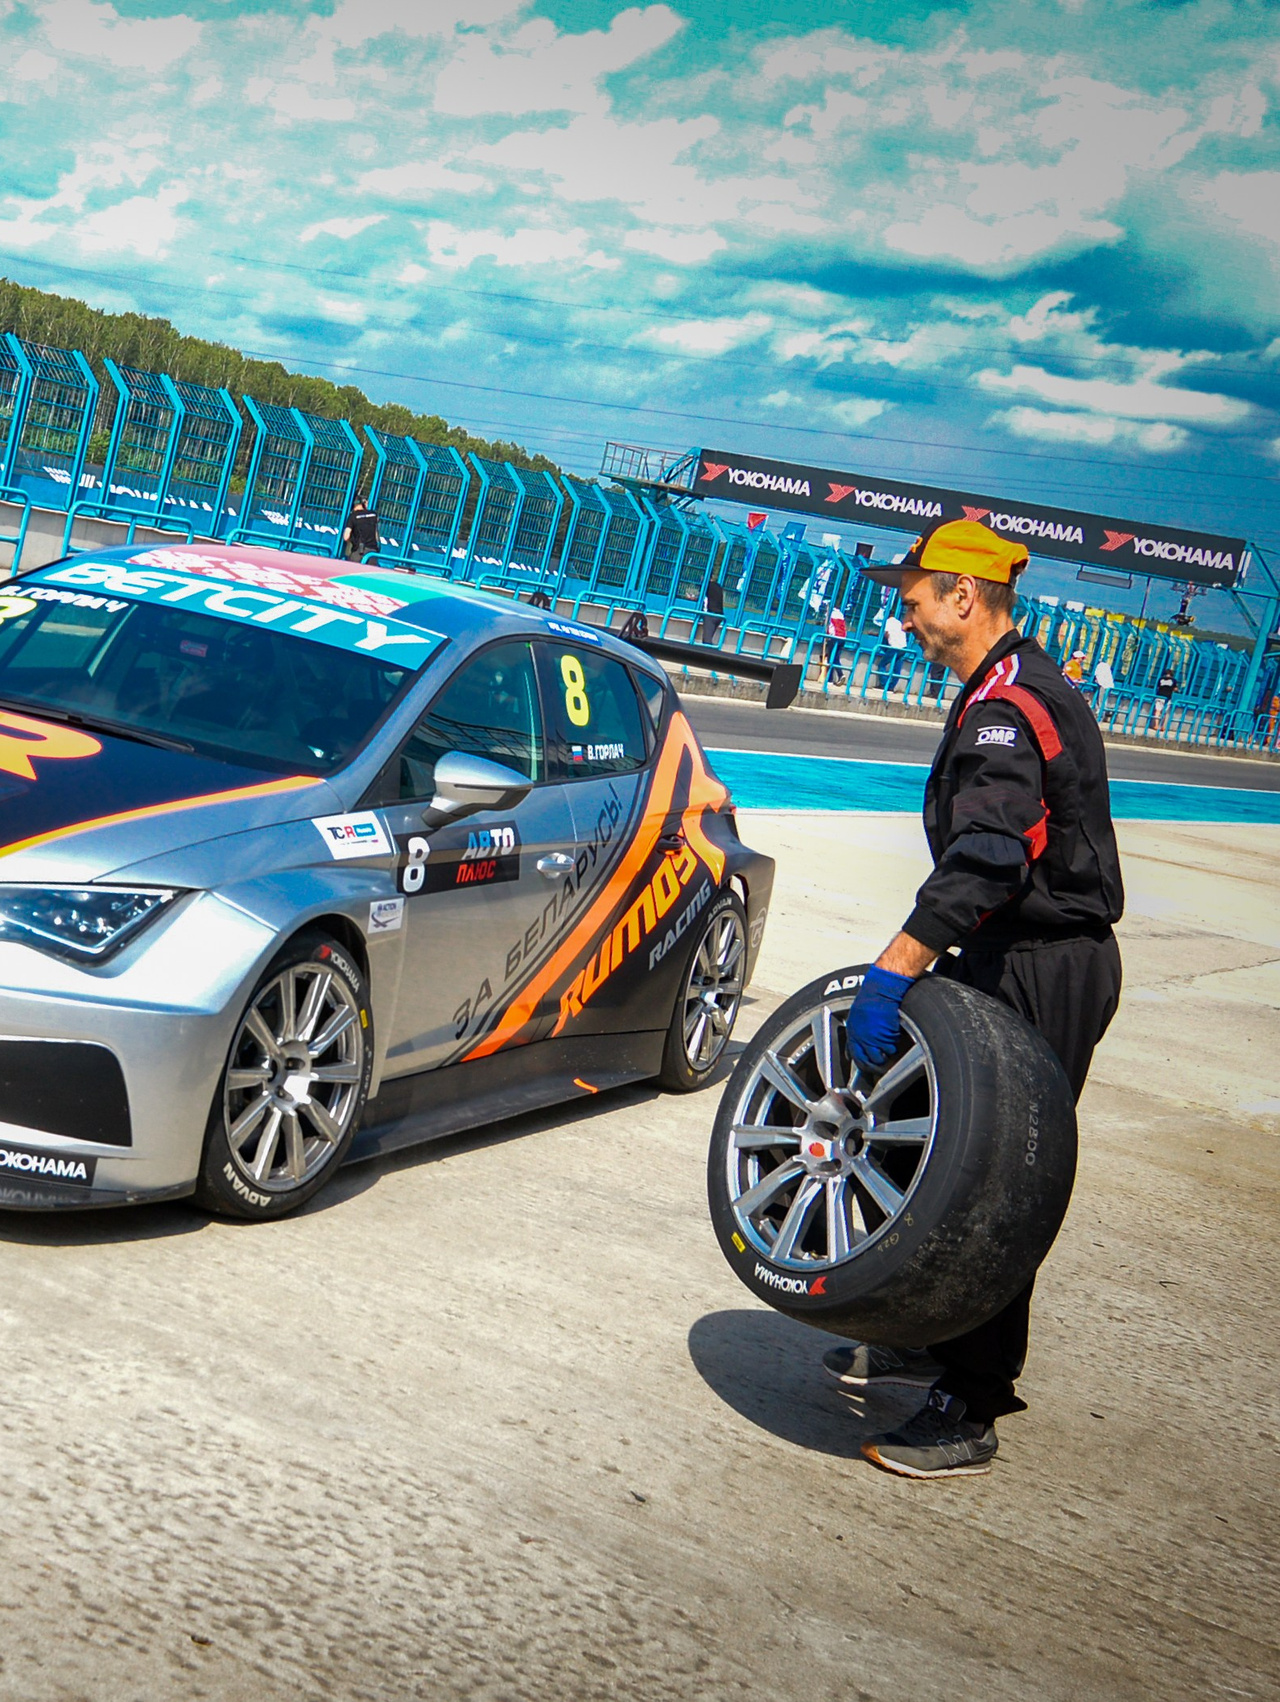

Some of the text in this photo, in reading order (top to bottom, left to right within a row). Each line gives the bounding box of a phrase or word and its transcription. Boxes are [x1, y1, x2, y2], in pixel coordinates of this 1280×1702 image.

[727, 468, 810, 497] YOKOHAMA
[854, 489, 942, 518] YOKOHAMA
[988, 512, 1083, 544] YOKOHAMA
[1133, 537, 1233, 570] YOKOHAMA
[43, 562, 431, 651] BETCITY
[560, 654, 590, 726] 8
[976, 727, 1017, 746] OMP
[327, 826, 356, 840] TCR
[461, 827, 515, 860] АВТО
[403, 836, 431, 893] 8
[456, 860, 497, 883] ПЛЮС
[551, 842, 698, 1038] RUMOS
[649, 878, 713, 971] RACING
[331, 950, 360, 993] YOKOHAMA
[223, 1161, 272, 1207] ADVAN
[754, 1262, 808, 1294] YOKOHAMA
